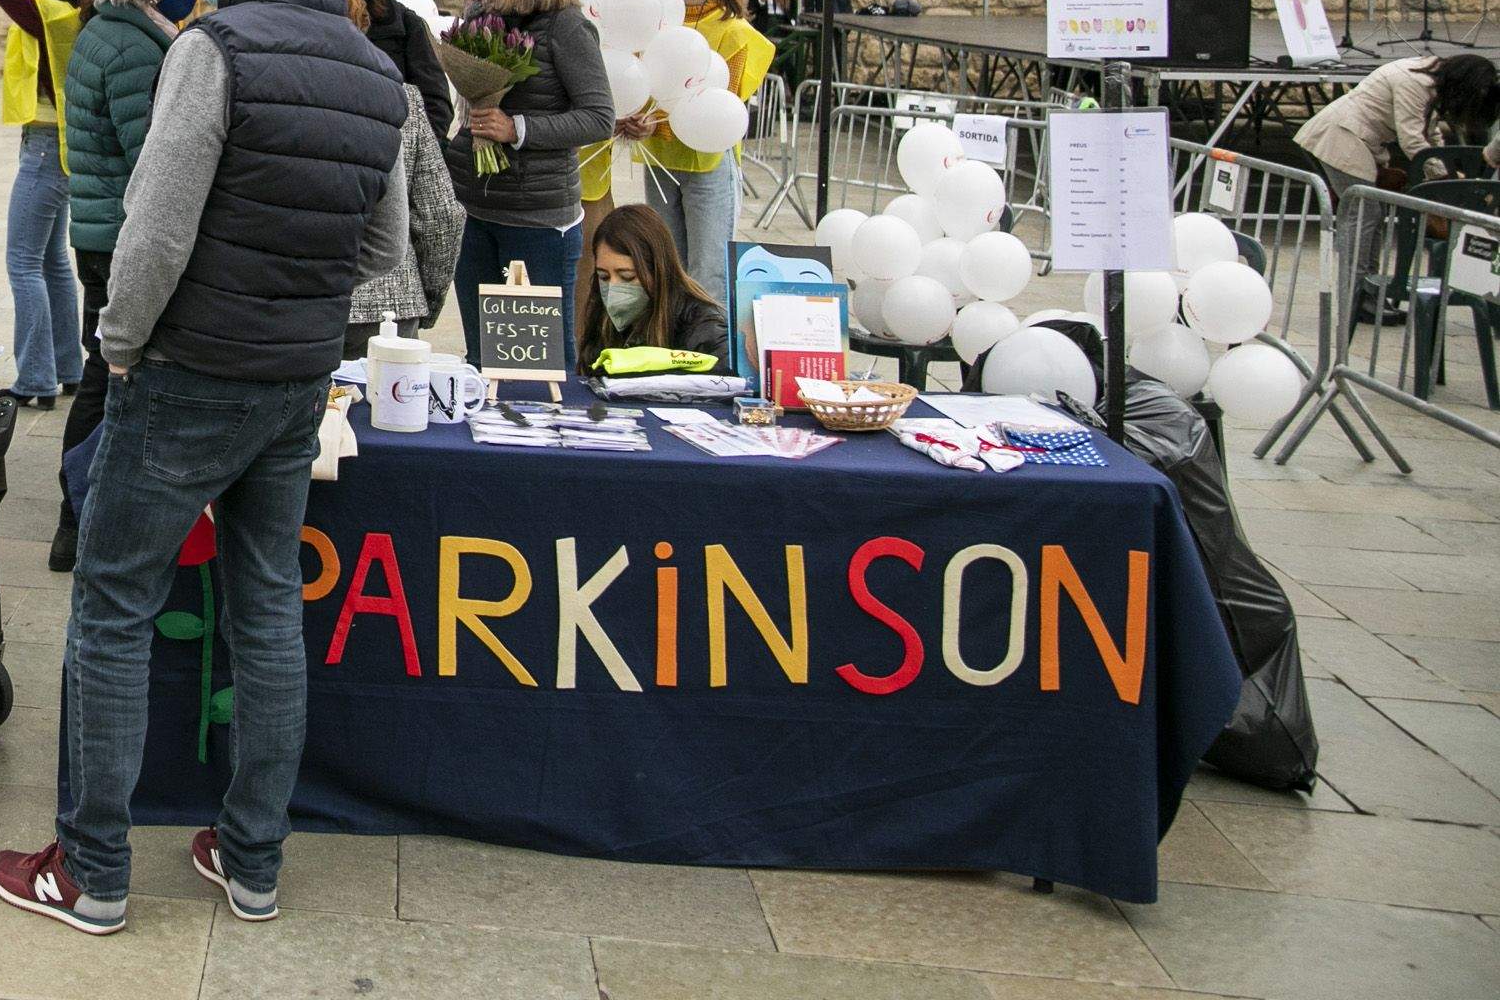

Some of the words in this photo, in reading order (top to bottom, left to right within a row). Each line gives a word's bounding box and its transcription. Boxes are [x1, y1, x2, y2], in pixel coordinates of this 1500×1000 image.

[959, 130, 999, 143] SORTIDA
[485, 321, 550, 338] FES-TE
[34, 872, 63, 901] N
